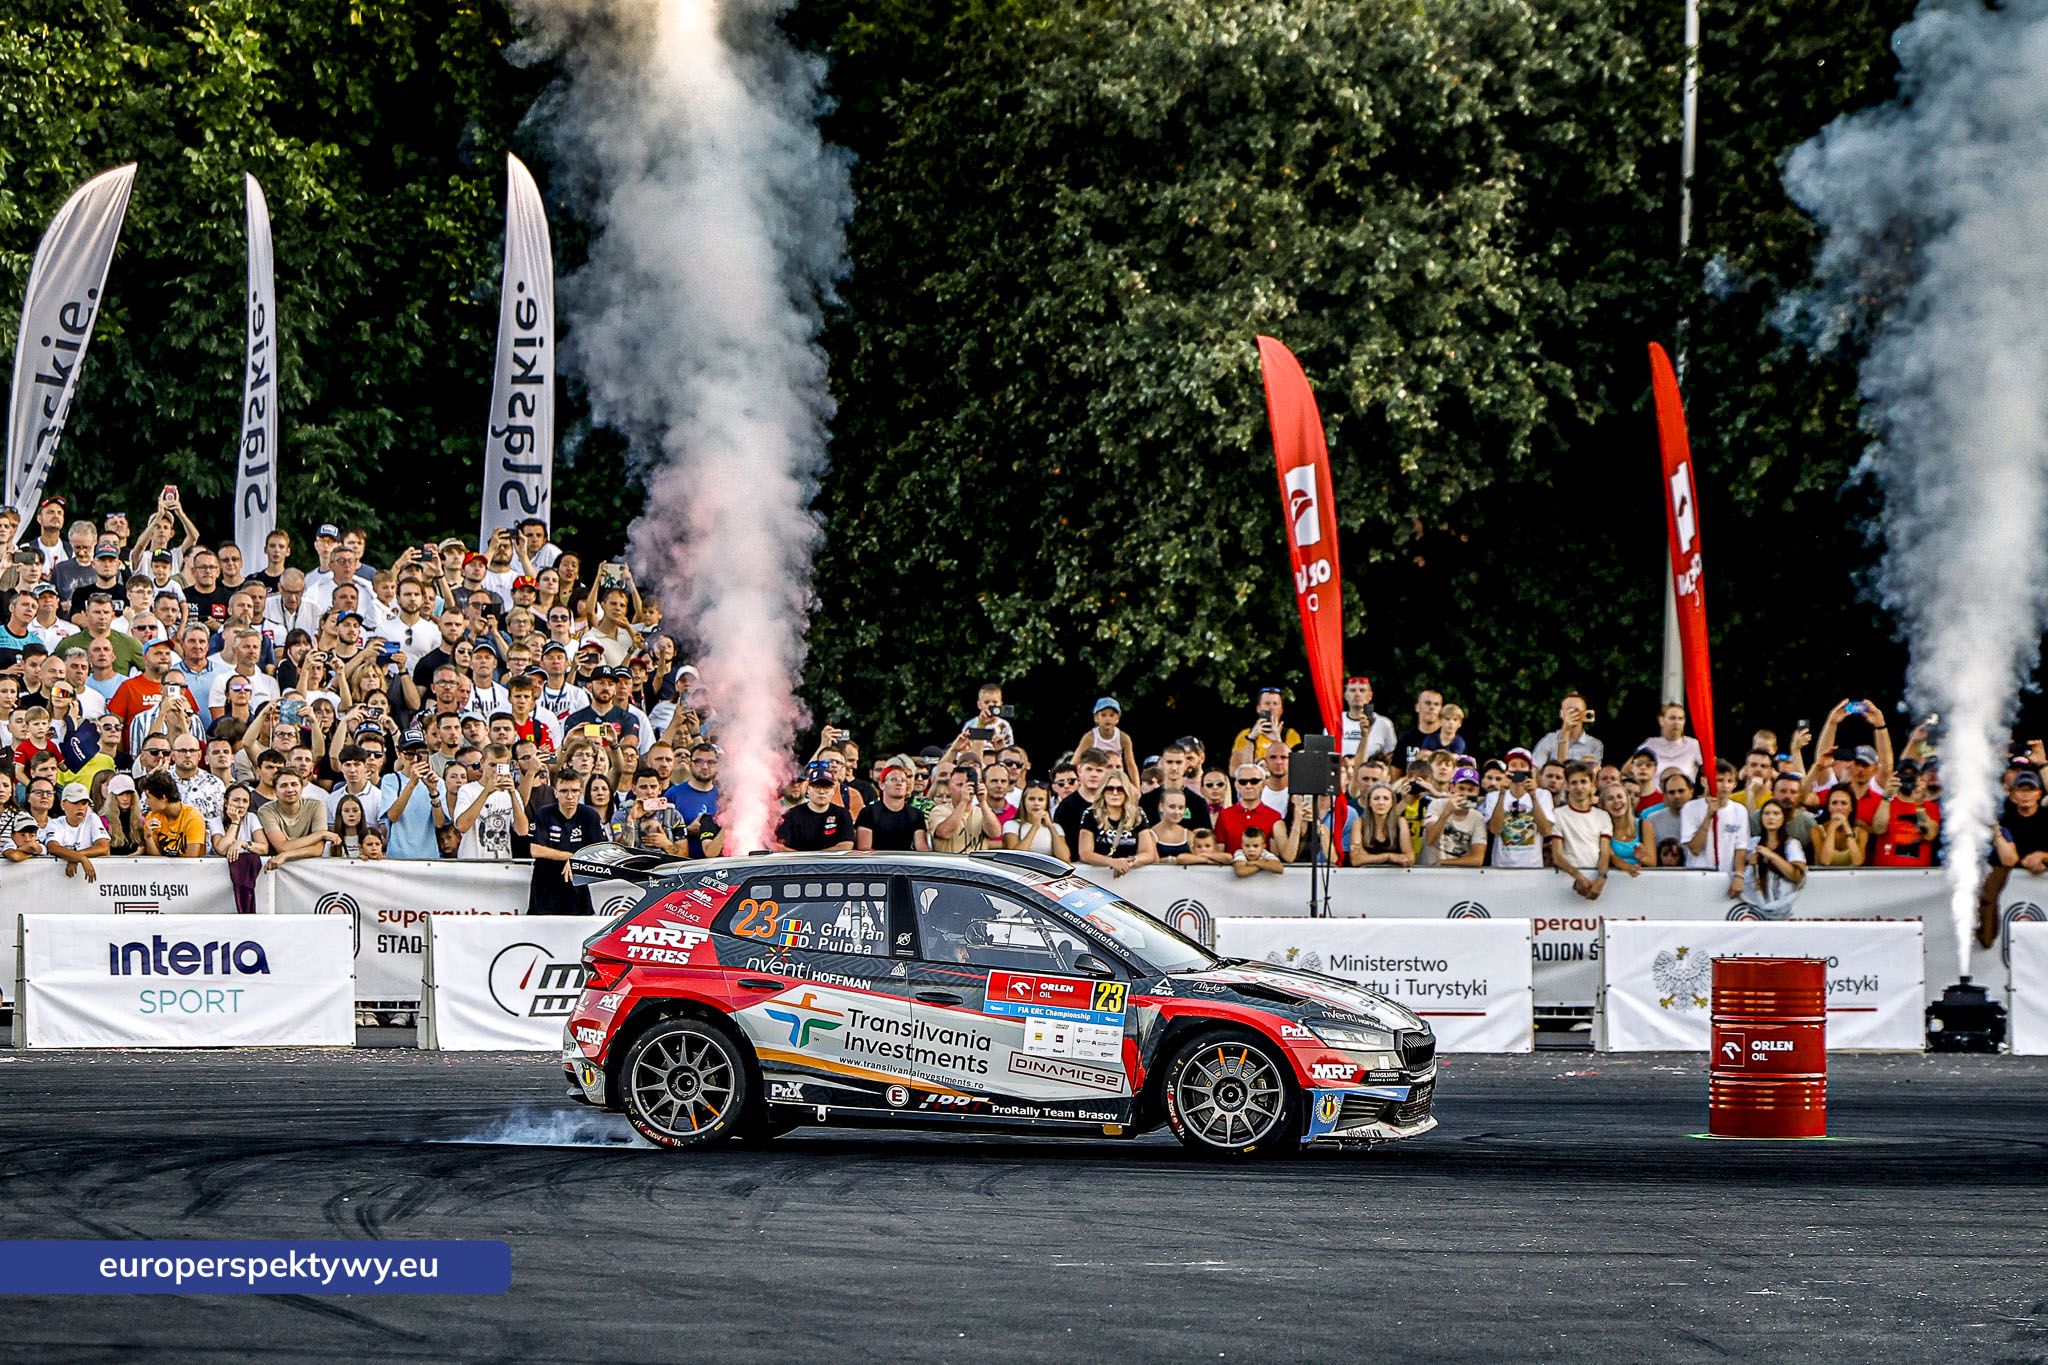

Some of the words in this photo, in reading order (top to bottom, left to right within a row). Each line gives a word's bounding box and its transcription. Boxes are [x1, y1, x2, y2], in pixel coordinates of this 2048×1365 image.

[100, 884, 146, 897] STADION
[150, 881, 188, 900] ŚLĄSKI
[677, 907, 701, 923] PALACE
[733, 898, 779, 939] 23
[620, 925, 709, 950] MRF
[801, 922, 816, 935] A.
[820, 923, 885, 942] Girtofan
[1063, 911, 1130, 957] andreigirtofan.ro
[378, 935, 422, 954] STAD
[798, 936, 814, 949] D.
[818, 937, 873, 955] Pulpea
[1533, 943, 1583, 961] ADION
[110, 935, 270, 976] interia
[626, 946, 691, 966] TYRES
[1330, 954, 1447, 972] Ministerstwo
[745, 955, 807, 979] nvent
[812, 971, 871, 990] HOFFMAN
[1040, 982, 1074, 993] ORLEN
[1150, 988, 1175, 996] PEAK
[1396, 978, 1400, 995] i
[1405, 979, 1487, 999] Turystyki
[1826, 974, 1879, 995] ystyki
[140, 989, 244, 1014] SPORT
[1039, 991, 1052, 999] OIL
[1095, 982, 1124, 1013] 23
[1017, 1006, 1029, 1015] FIA
[1031, 1007, 1043, 1016] ERC
[1045, 1008, 1091, 1022] Championship
[1322, 1009, 1355, 1022] nvent
[576, 1025, 607, 1046] MRF
[848, 1008, 991, 1052] Transilvania
[844, 1031, 989, 1075] Investments
[1751, 1041, 1794, 1051] ORLEN
[1751, 1052, 1768, 1061] OIL
[839, 1056, 984, 1090] www.transilvaniainvestments.ro
[1015, 1059, 1119, 1086] DINAMIC92
[1311, 1063, 1358, 1079] MRF
[992, 1105, 1039, 1117] ProRally
[1043, 1107, 1075, 1118] Team
[1078, 1109, 1118, 1121] Brasov
[1347, 1130, 1372, 1138] Mobil
